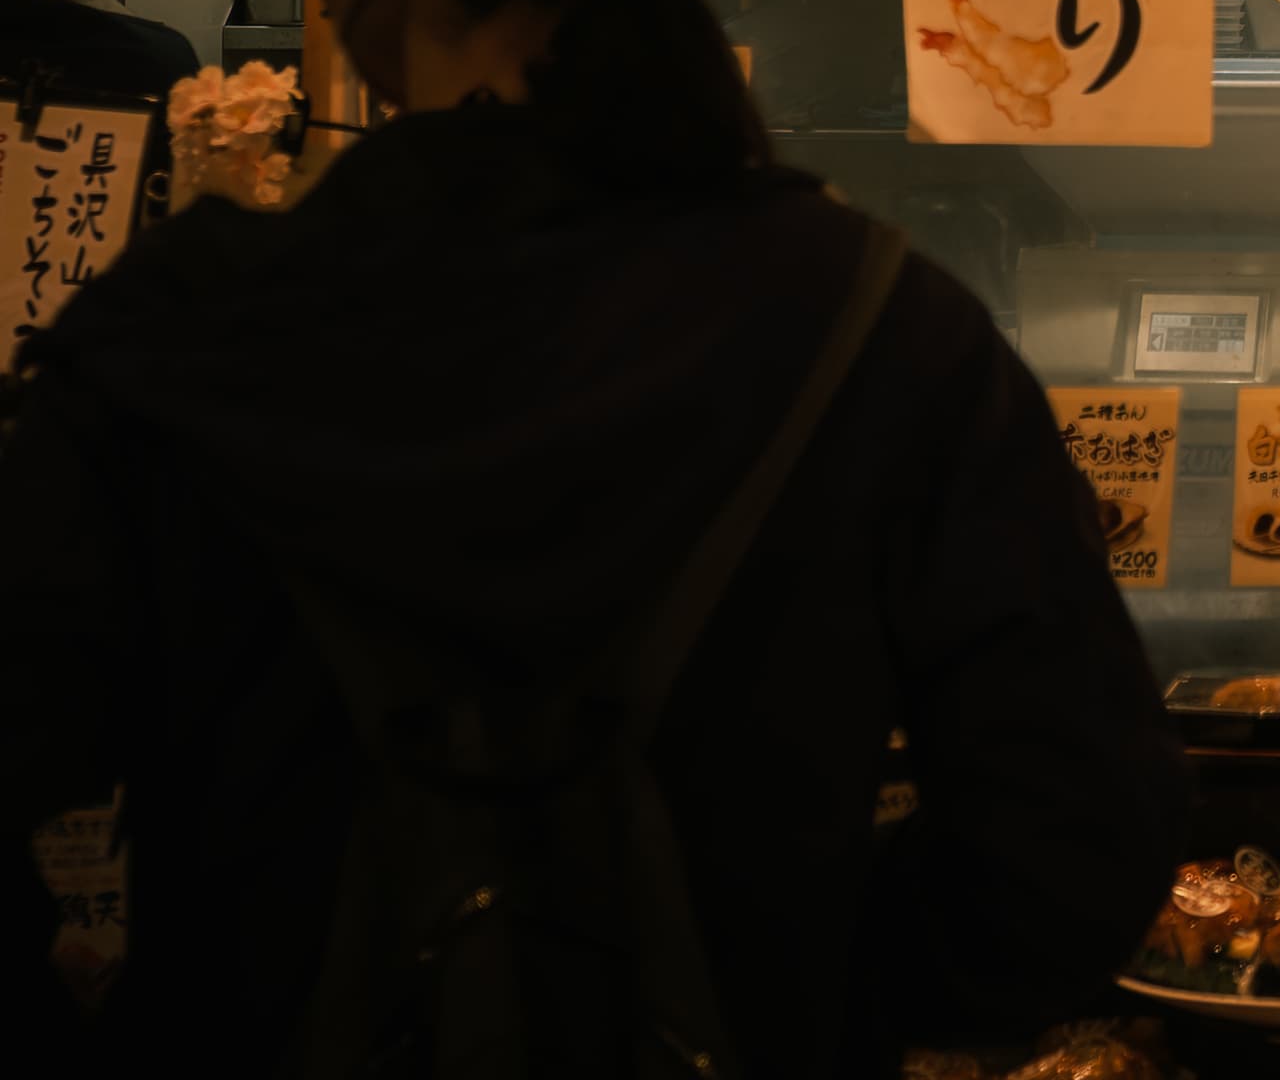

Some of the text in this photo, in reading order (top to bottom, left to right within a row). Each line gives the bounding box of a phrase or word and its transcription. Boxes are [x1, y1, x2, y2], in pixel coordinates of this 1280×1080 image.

[61, 133, 117, 286] 具沢山
[1079, 404, 1147, 421] 二種あん
[1102, 488, 1133, 498] CAKE
[1112, 551, 1157, 568] ¥200
